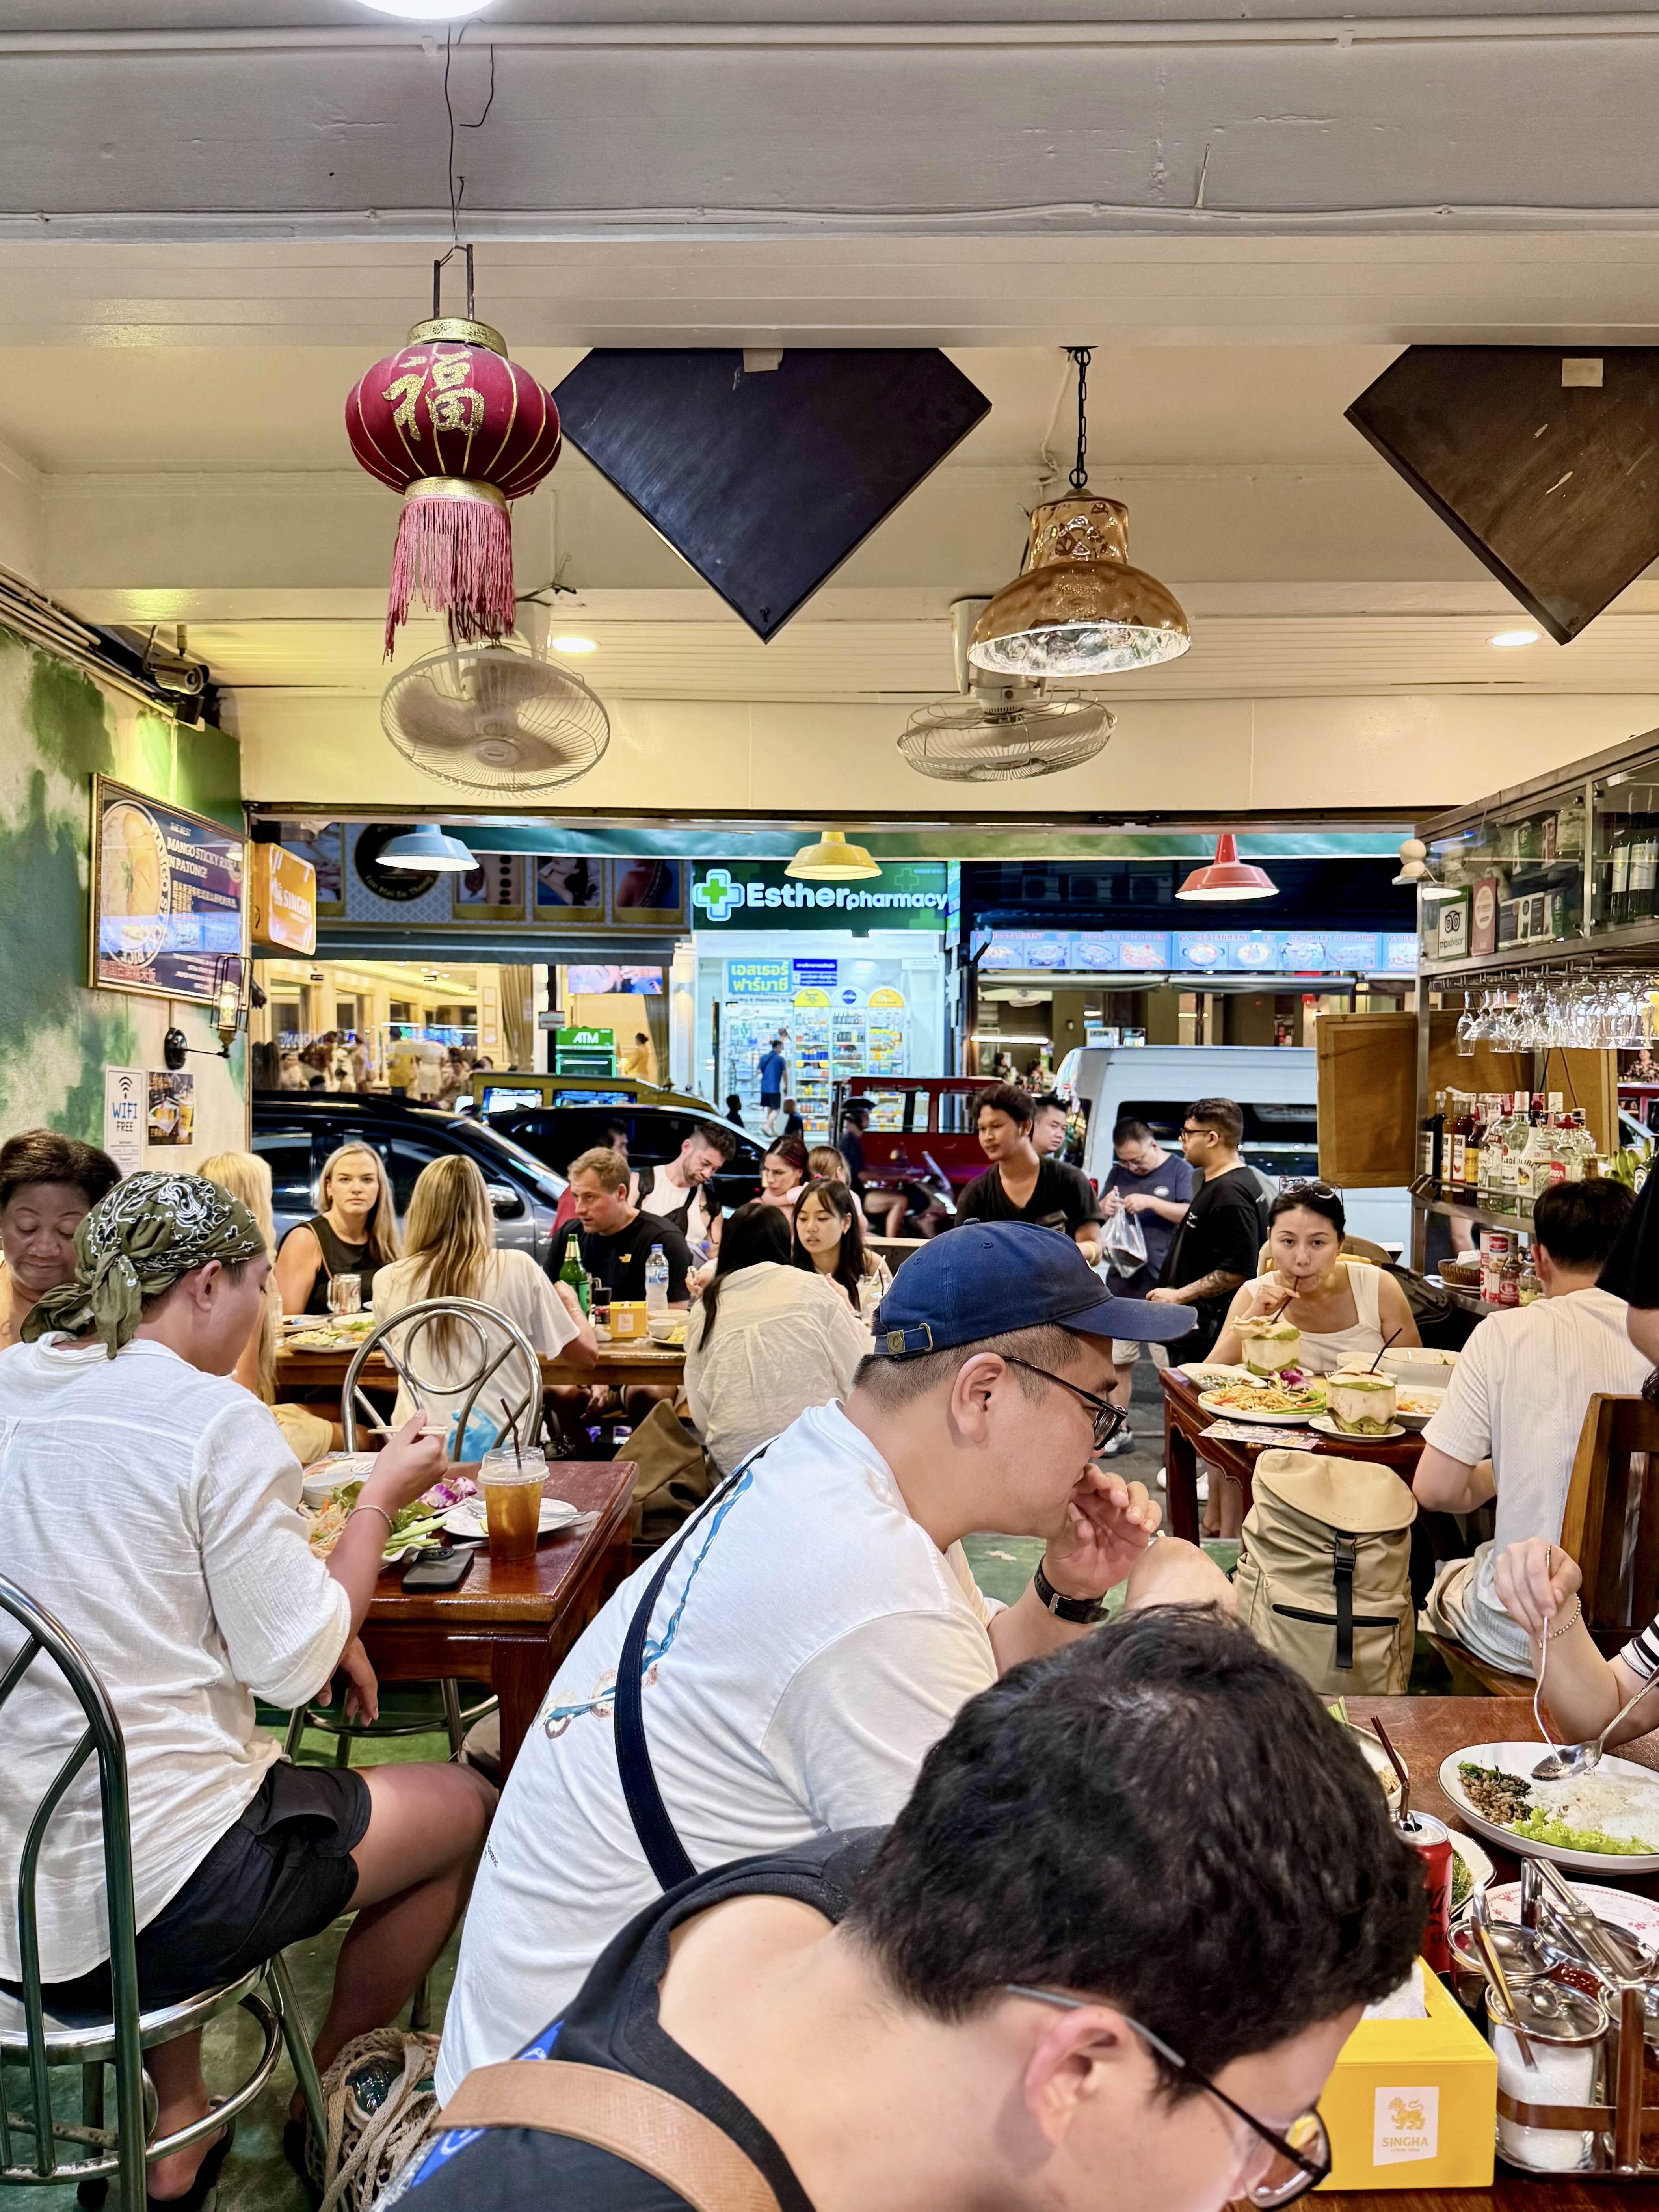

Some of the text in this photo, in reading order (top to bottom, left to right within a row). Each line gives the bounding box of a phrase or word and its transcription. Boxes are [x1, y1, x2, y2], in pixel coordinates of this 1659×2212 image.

[381, 350, 485, 441] 福
[167, 836, 195, 858] MANGO
[195, 847, 219, 866] STICKY
[167, 855, 208, 879] IN PATONG!
[283, 889, 312, 919] SINGHA
[747, 883, 948, 910] Esther pharmacy
[1440, 937, 1464, 950] tripadvisor
[731, 961, 789, 976] เอสเธอร์
[733, 977, 789, 991] ฟาร์มาซี
[573, 1032, 599, 1044] ATM
[112, 1102, 137, 1119] WIFI
[117, 1121, 133, 1132] FREE
[1382, 2137, 1428, 2147] SINGHA
